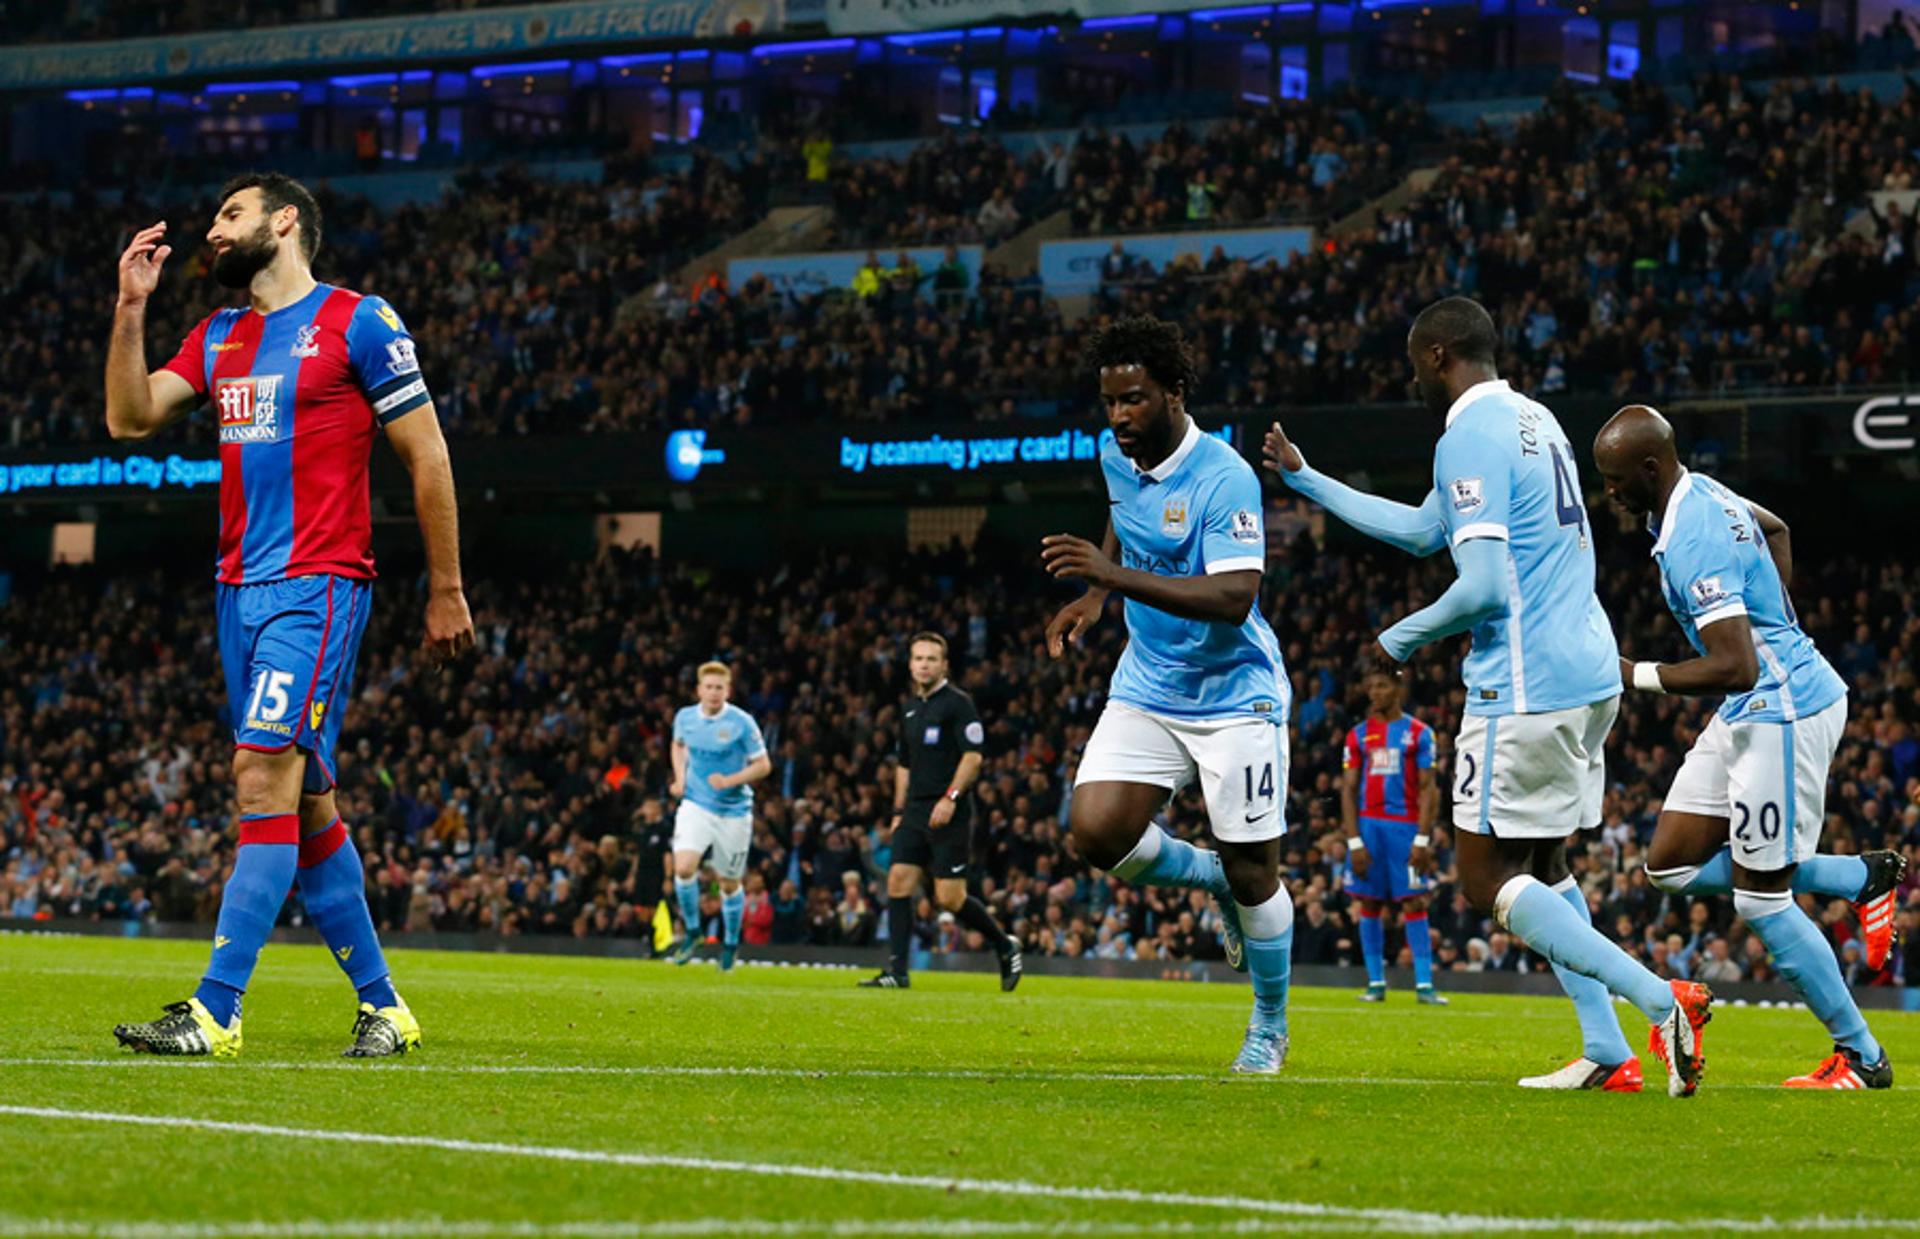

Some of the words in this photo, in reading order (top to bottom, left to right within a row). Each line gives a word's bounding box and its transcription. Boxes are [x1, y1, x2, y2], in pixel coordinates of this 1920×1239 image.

[220, 426, 276, 441] MANSION
[841, 437, 868, 473] by
[870, 434, 964, 470] scanning
[966, 439, 1017, 469] your
[1019, 430, 1069, 462] card
[1073, 430, 1094, 460] in
[9, 464, 54, 492] your
[55, 457, 100, 486] card
[101, 457, 121, 484] in
[123, 456, 165, 489] City
[1549, 443, 1584, 536] 4
[247, 669, 295, 722] 15
[1245, 763, 1274, 802] 14
[1734, 801, 1780, 841] 20
